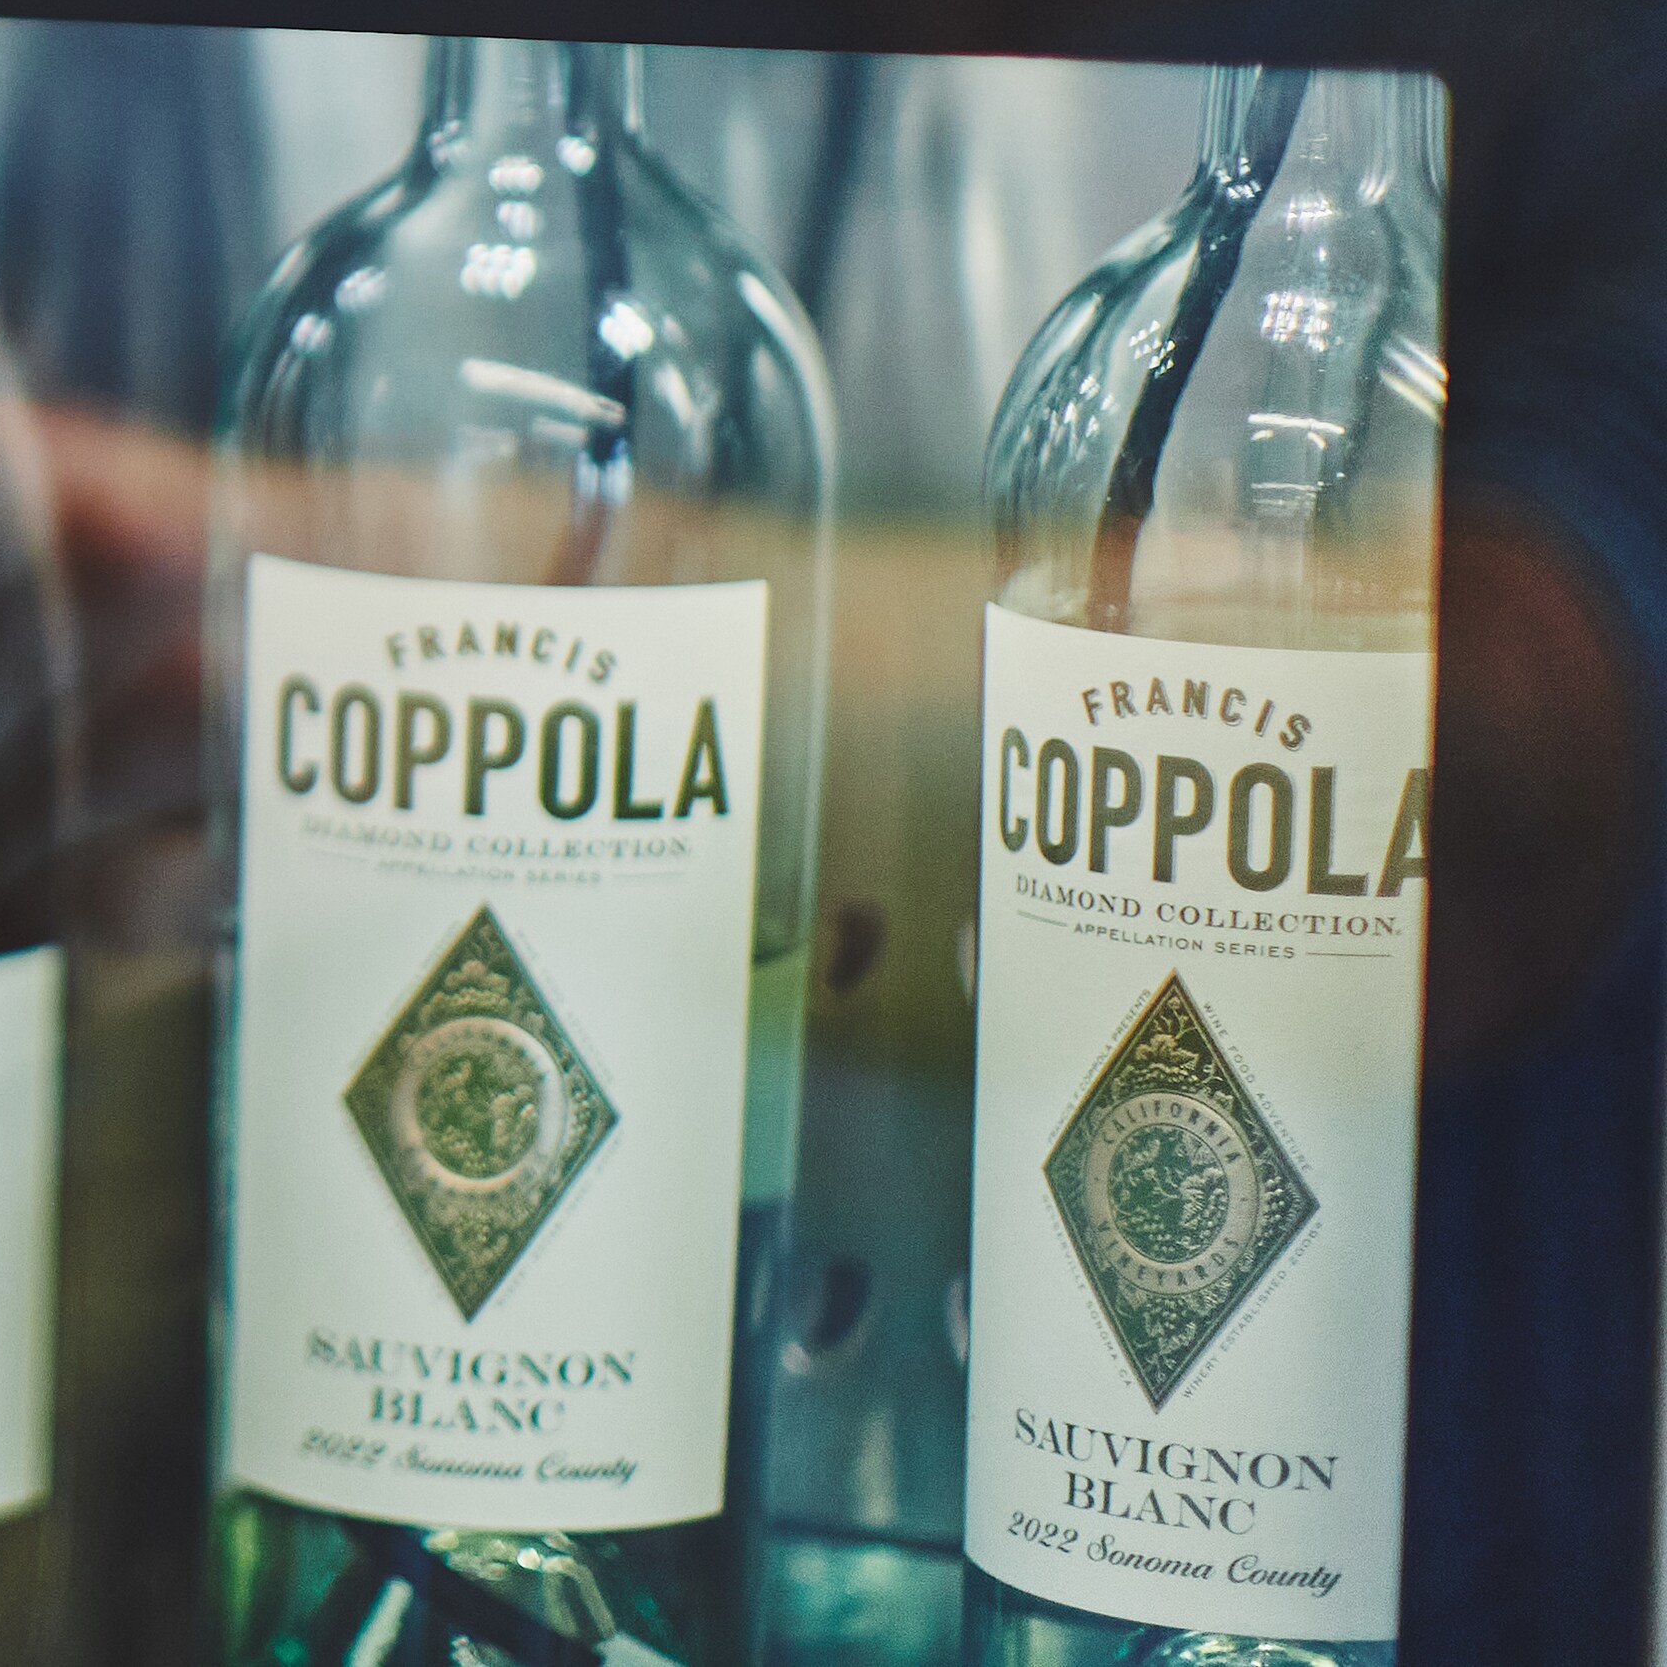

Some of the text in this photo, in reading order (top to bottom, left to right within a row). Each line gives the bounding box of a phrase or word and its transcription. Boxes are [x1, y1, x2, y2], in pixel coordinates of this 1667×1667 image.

[385, 622, 617, 685] FRANCIS
[1081, 677, 1312, 751] FRANCIS
[276, 671, 730, 821] COPPOLA
[999, 726, 1431, 897] COPPOLA
[468, 834, 691, 860] COLLECTION
[1017, 873, 1400, 936] DIAMOND COLLECTION
[1074, 922, 1295, 959] APPELLATION SERIES
[1200, 1001, 1229, 1039] WINE
[1226, 1043, 1257, 1085] FOOD
[1103, 1100, 1242, 1164] CALIFORNIA
[307, 1330, 635, 1389] SAUVIGNON
[1181, 1353, 1220, 1401] WINERY
[369, 1386, 564, 1434] BLANC
[393, 1444, 524, 1481] Sonoma
[536, 1453, 637, 1488] County
[1014, 1407, 1338, 1491] SAUVIGNON
[1064, 1470, 1256, 1535] BLANC
[1008, 1511, 1344, 1597] 2022 Sonoma County
